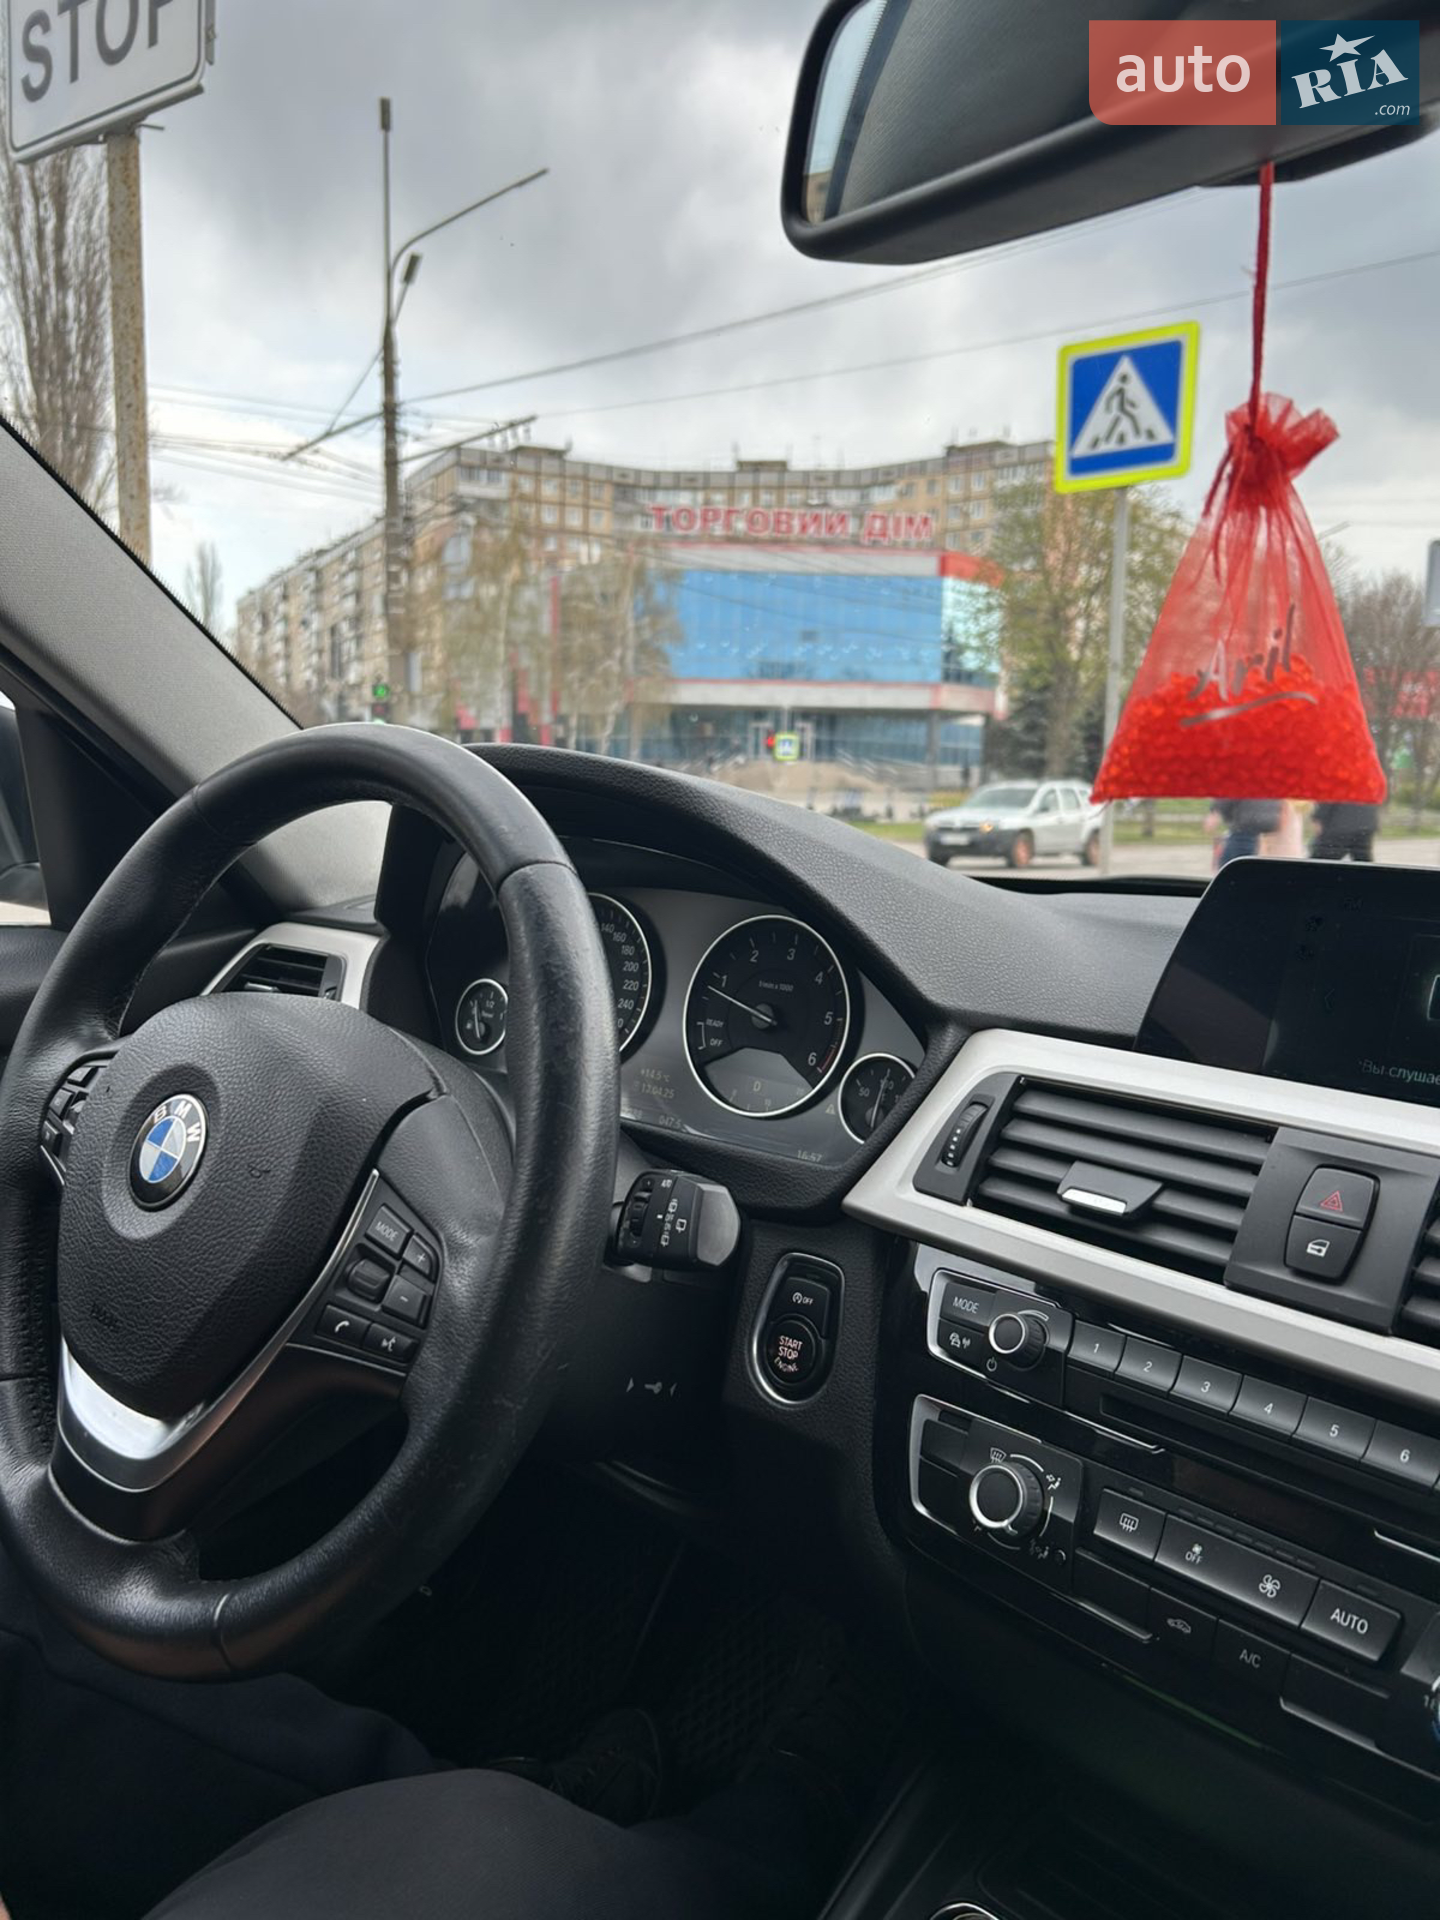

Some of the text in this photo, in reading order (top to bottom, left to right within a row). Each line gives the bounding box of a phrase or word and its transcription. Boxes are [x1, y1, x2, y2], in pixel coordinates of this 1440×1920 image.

[621, 945, 635, 956] 180
[750, 950, 759, 963] 2
[787, 948, 796, 961] 3
[623, 961, 639, 972] 200
[721, 974, 728, 988] 1
[815, 971, 824, 985] 4
[622, 979, 639, 991] 220
[617, 997, 634, 1010] 240
[706, 1018, 724, 1028] READY
[824, 1011, 834, 1025] 5
[709, 1037, 723, 1048] OFF
[808, 1051, 817, 1066] 6
[858, 1086, 870, 1097] 50
[152, 1099, 201, 1143] BMW
[374, 1221, 399, 1242] MODE
[802, 1296, 814, 1306] OFF
[952, 1297, 980, 1316] MODE
[778, 1335, 803, 1351] START
[1093, 1342, 1100, 1354] 1
[778, 1346, 799, 1361] STOP
[1143, 1360, 1154, 1373] 2
[1201, 1381, 1211, 1394] 3
[1263, 1402, 1274, 1415] 4
[1329, 1424, 1340, 1437] 5
[1399, 1449, 1411, 1463] 6
[1184, 1551, 1204, 1565] OFF
[1330, 1607, 1369, 1635] AUTO
[1239, 1648, 1261, 1670] A/C
